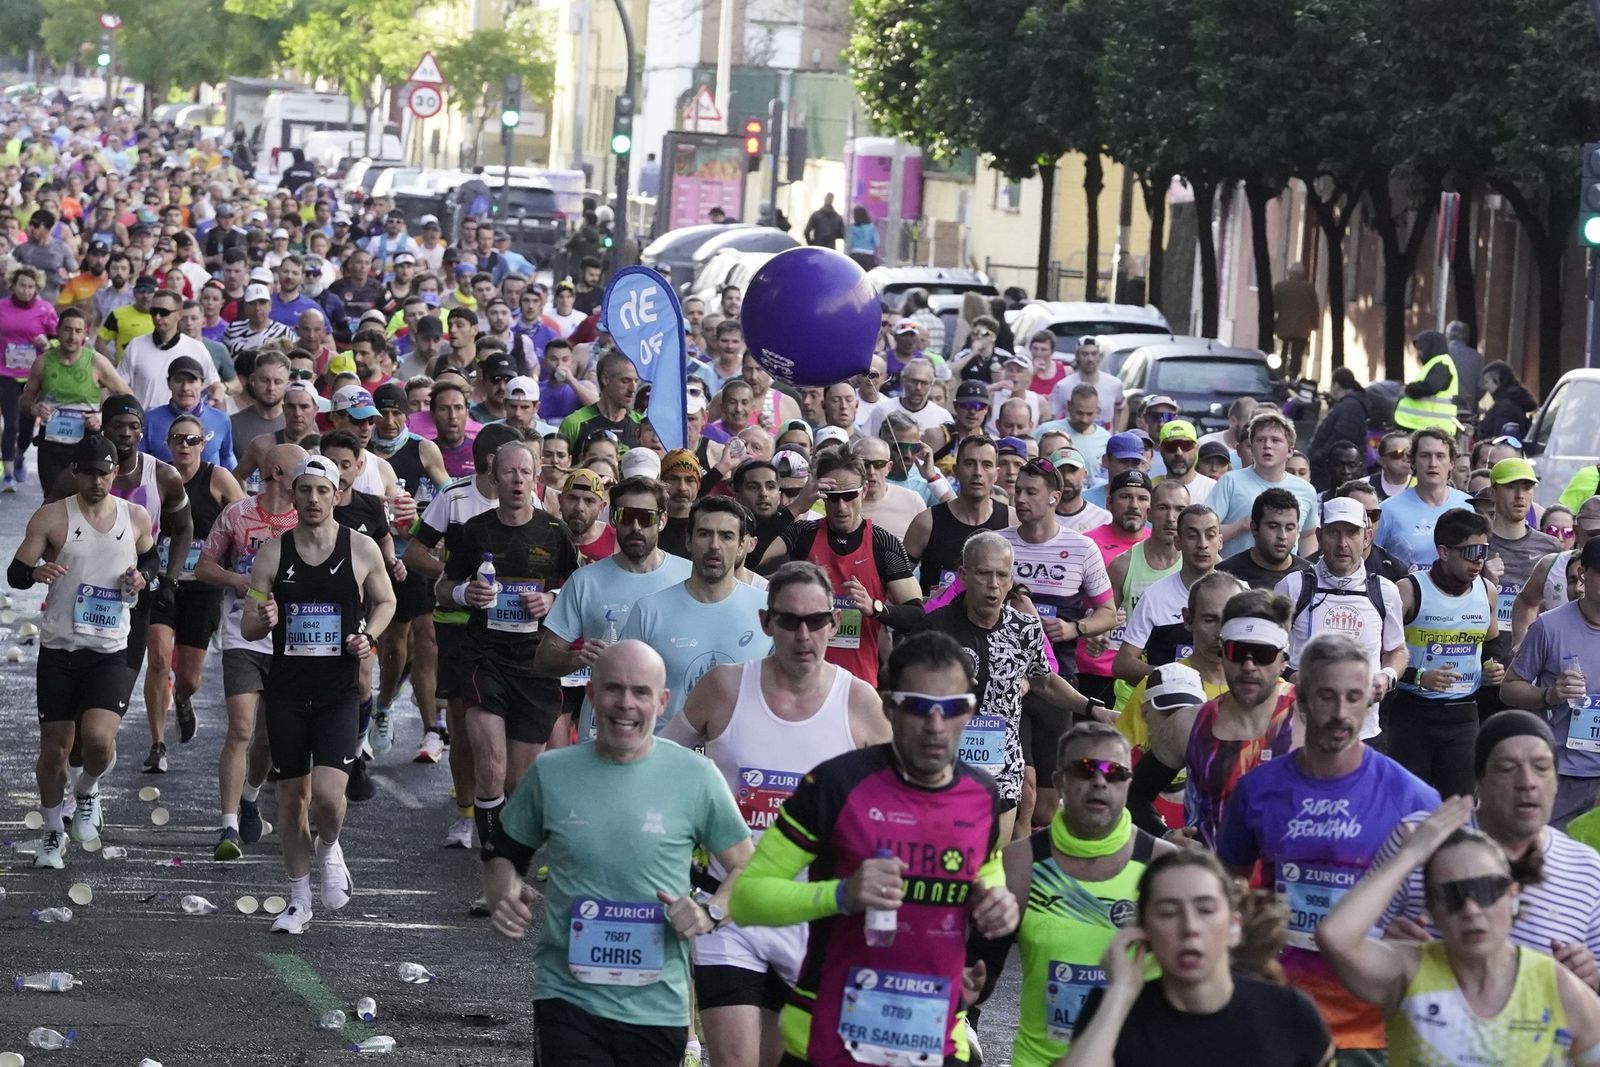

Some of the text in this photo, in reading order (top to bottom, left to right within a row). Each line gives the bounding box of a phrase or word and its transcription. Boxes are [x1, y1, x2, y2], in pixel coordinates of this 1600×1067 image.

[506, 585, 537, 593] ZURICH
[302, 605, 335, 614] ZURICH
[83, 611, 117, 626] GUIRAO
[288, 632, 321, 643] GUILLE
[1446, 646, 1471, 654] ZURICH
[965, 737, 985, 746] 7218
[959, 748, 990, 762] PACO
[1305, 869, 1355, 884] ZURICH
[605, 906, 655, 919] ZURICH
[604, 931, 631, 943] 7687
[590, 946, 641, 965] CHRIS
[881, 1005, 912, 1020] 8789
[841, 1021, 942, 1050] FER SANABRIA
